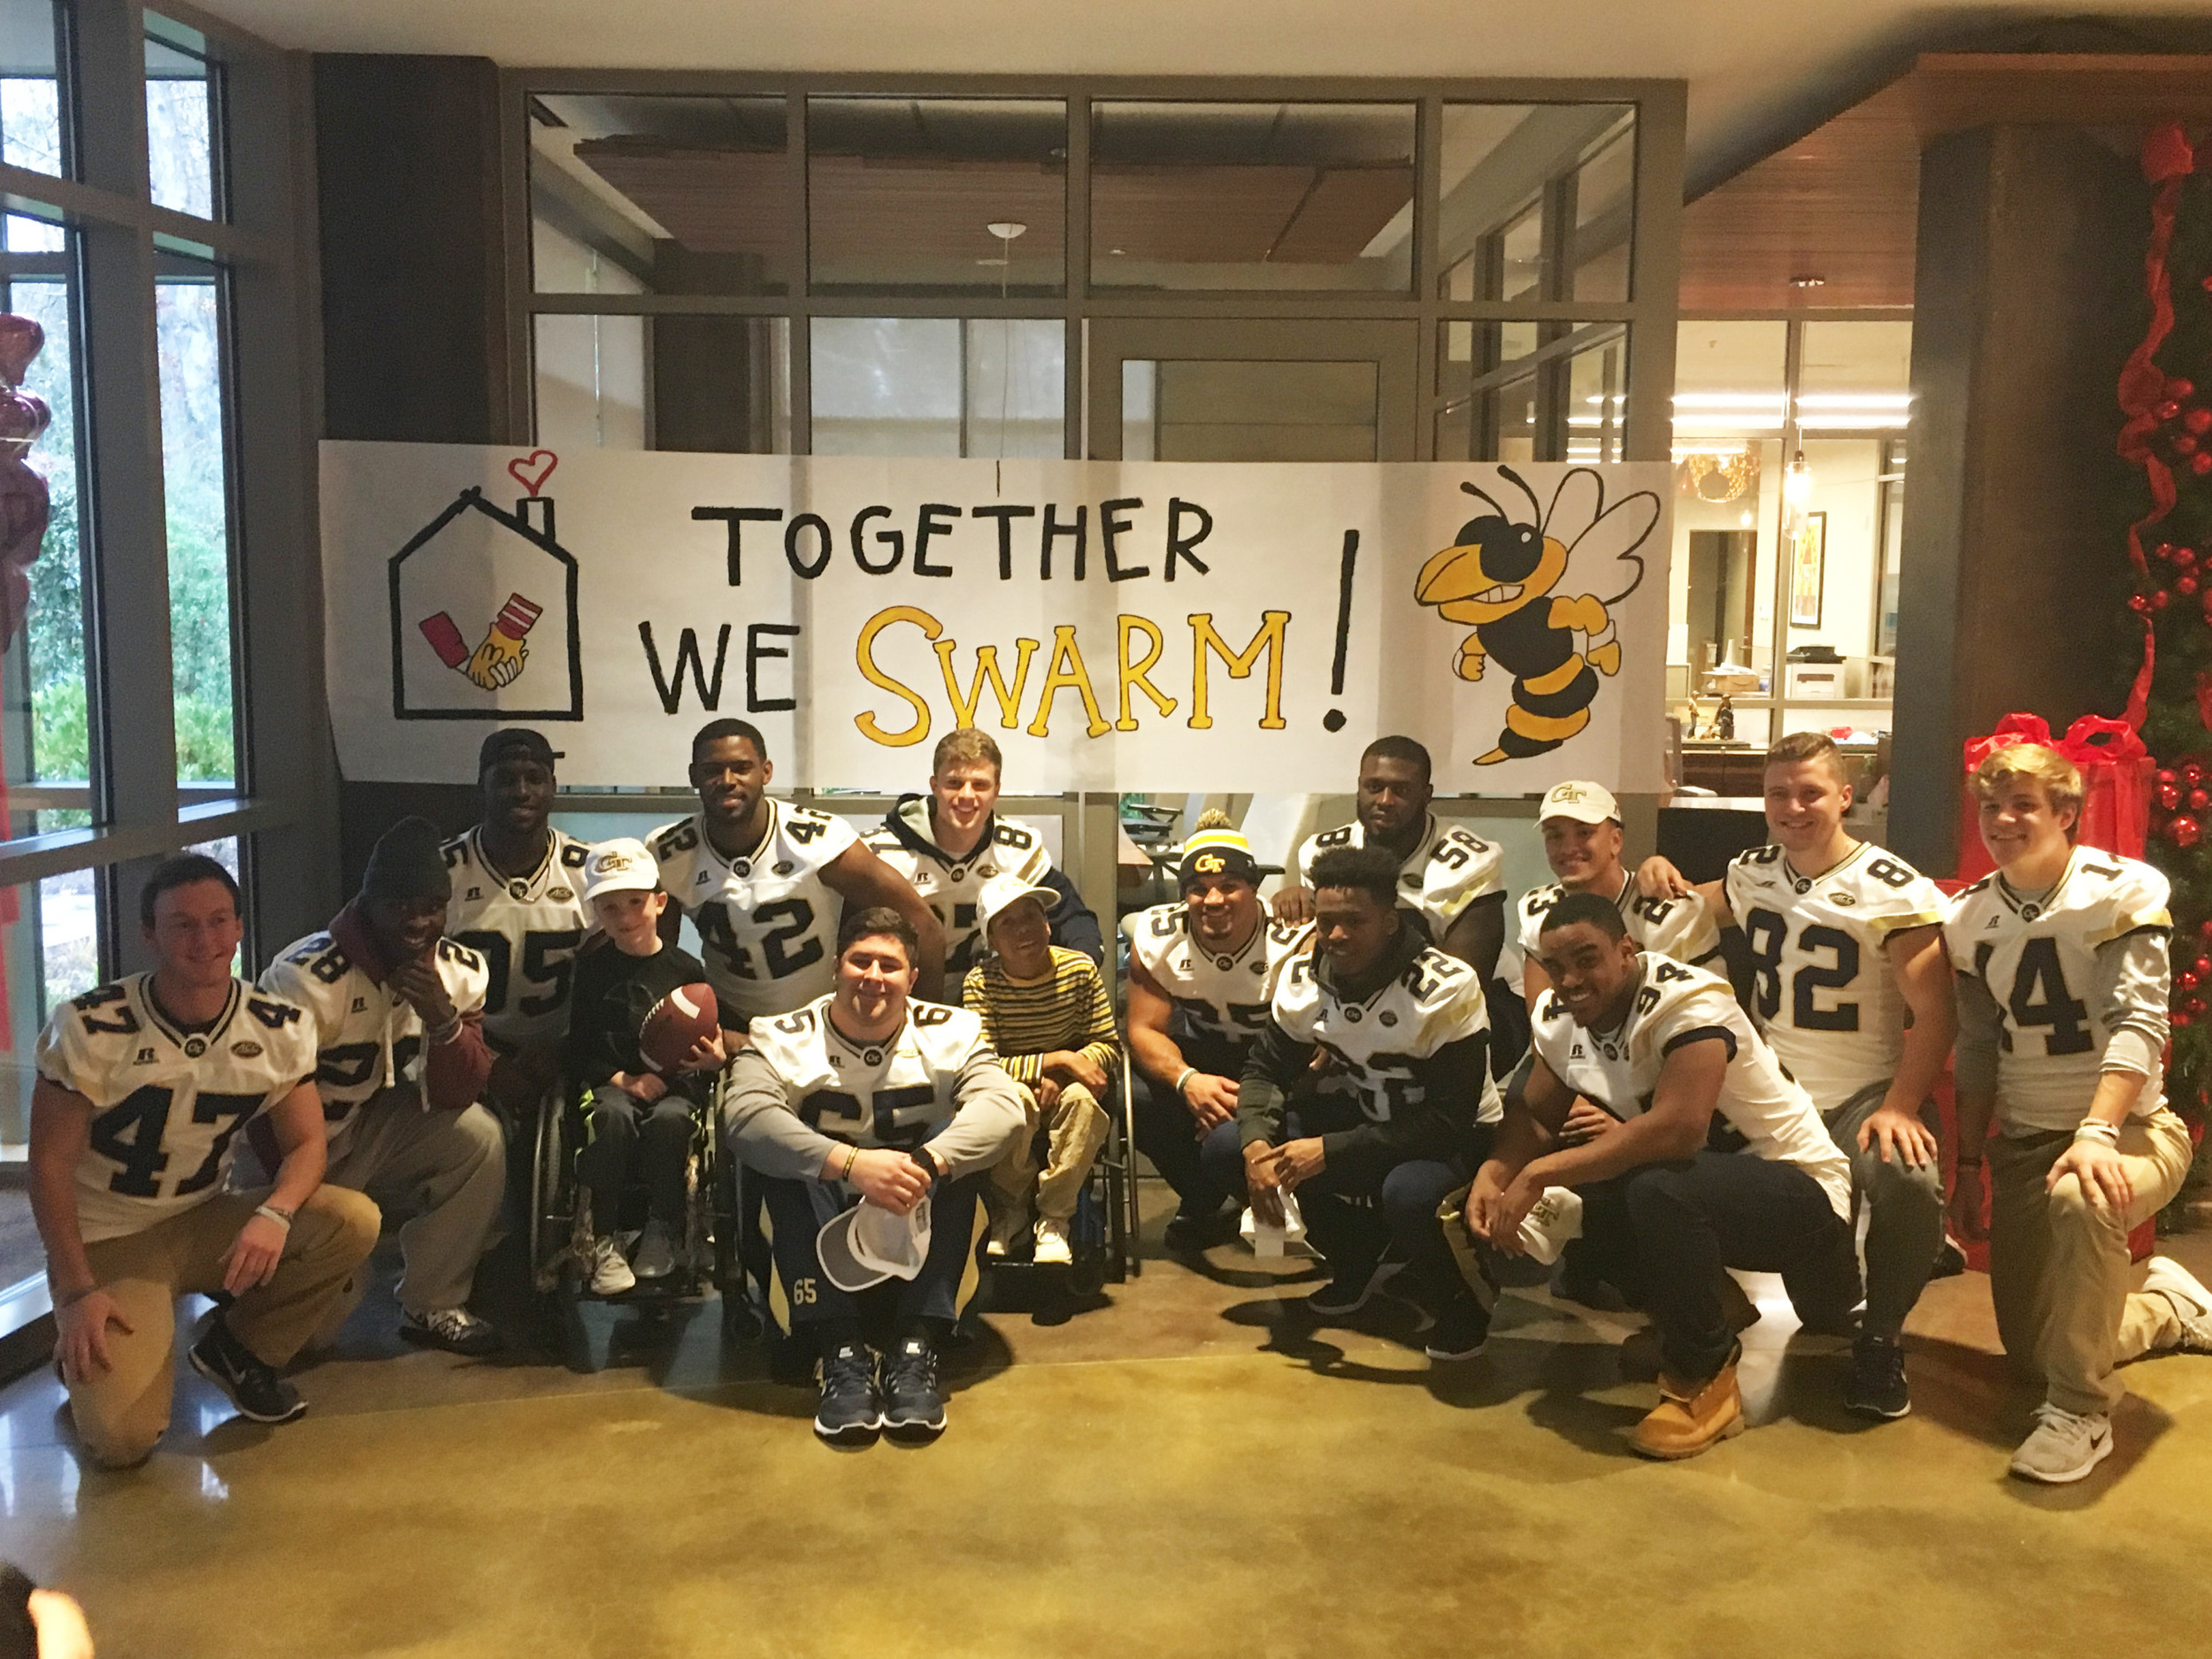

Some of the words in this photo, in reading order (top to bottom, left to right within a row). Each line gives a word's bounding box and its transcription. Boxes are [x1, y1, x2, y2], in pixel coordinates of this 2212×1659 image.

[691, 497, 1213, 586] TOGETHER
[638, 620, 800, 716] WE
[854, 605, 1292, 748] SWARM
[1551, 784, 1586, 803] GT
[1194, 853, 1226, 873] GT
[1430, 830, 1489, 870] 58
[1527, 883, 1566, 916] 3
[696, 897, 824, 980] 42
[1745, 906, 1859, 1032] 82
[90, 1083, 268, 1199] 47
[793, 1278, 818, 1305] 65
